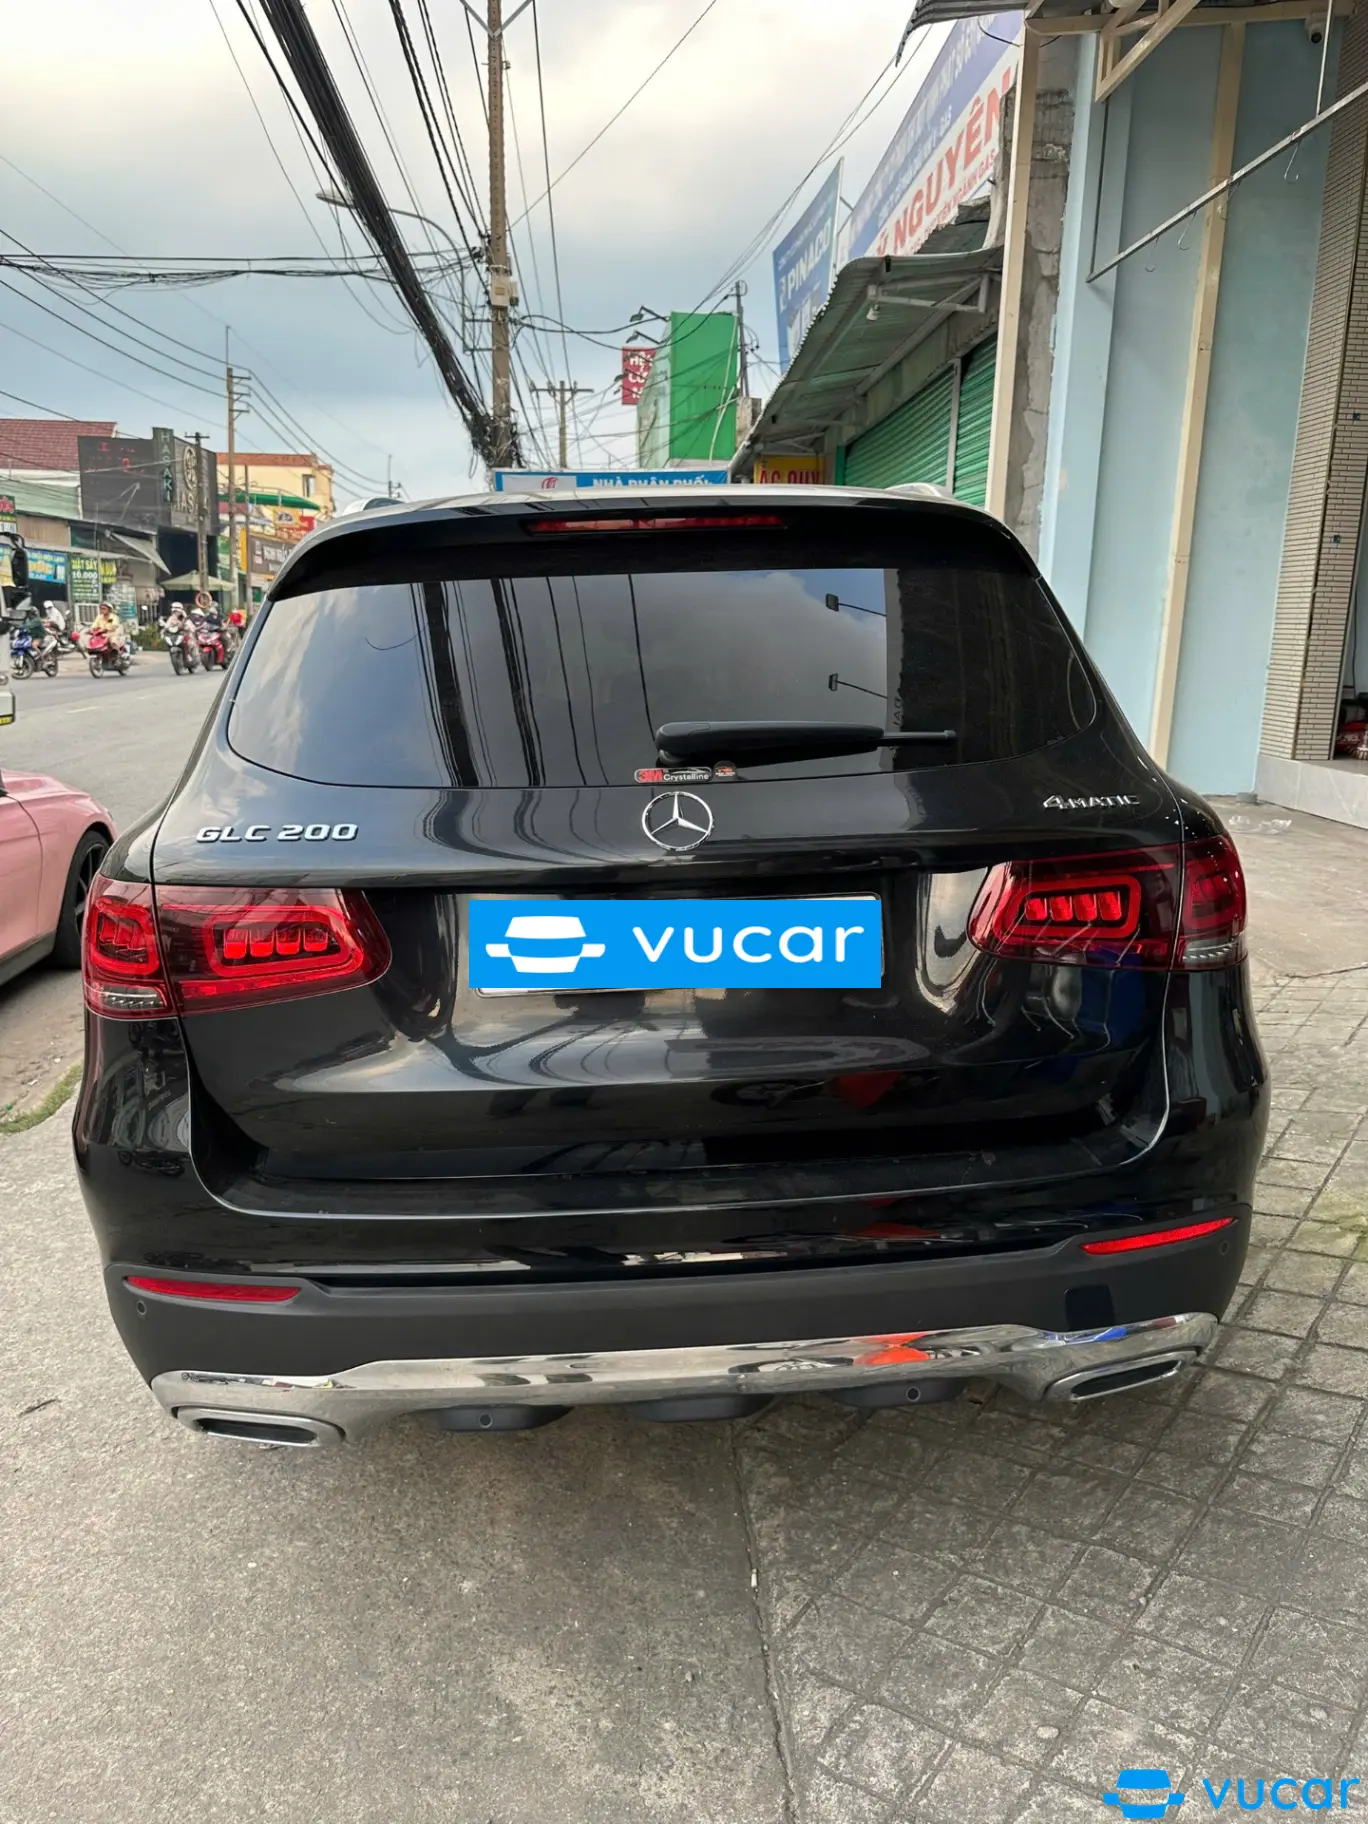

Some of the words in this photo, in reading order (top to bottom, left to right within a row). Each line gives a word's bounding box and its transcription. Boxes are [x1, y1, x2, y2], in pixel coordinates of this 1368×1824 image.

[161, 431, 173, 502] HASAKI
[664, 772, 709, 781] Crystalline
[196, 825, 271, 843] GLC
[277, 823, 359, 842] 200
